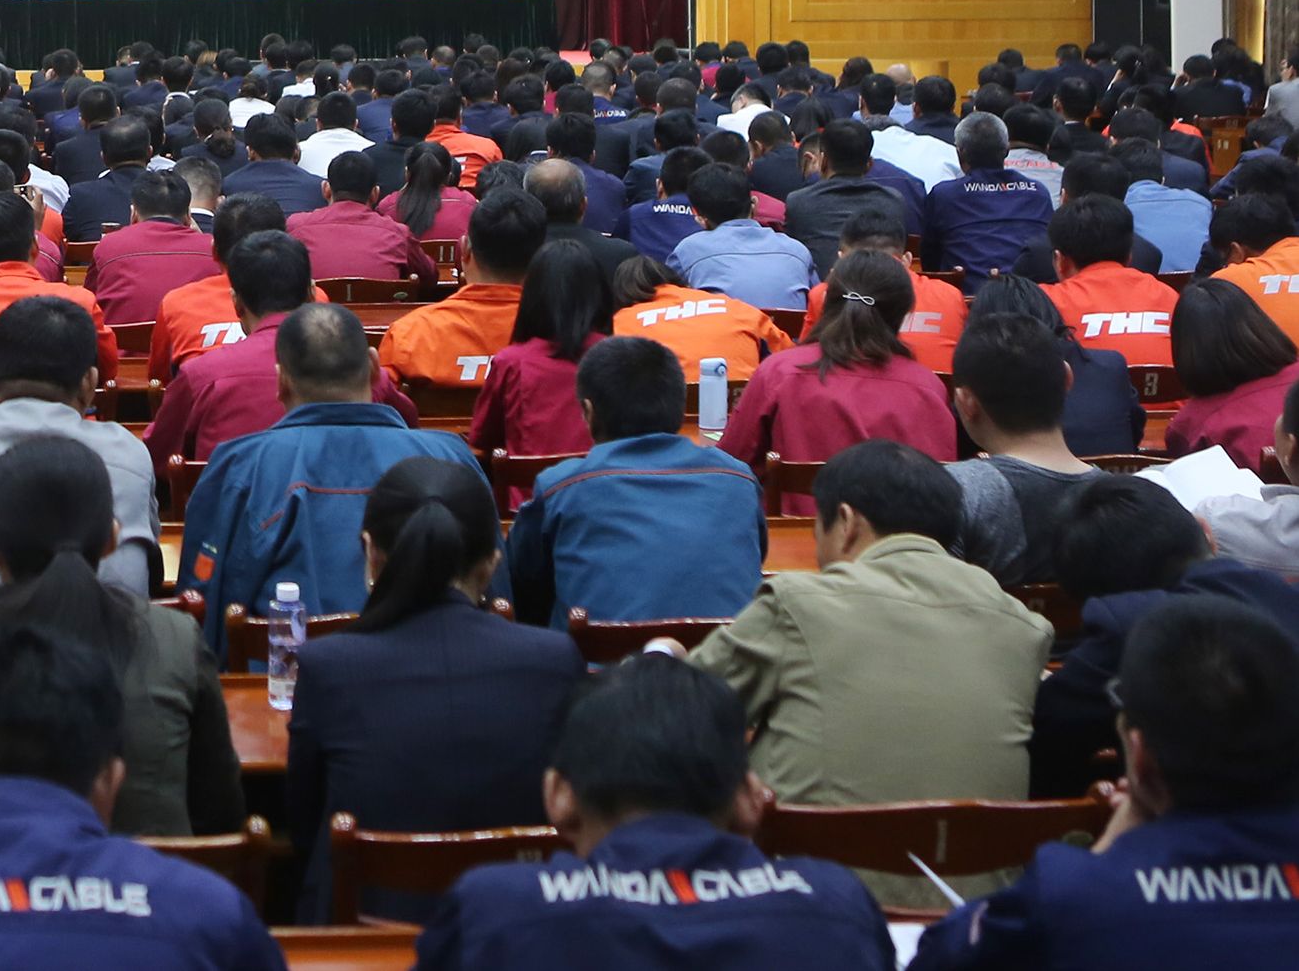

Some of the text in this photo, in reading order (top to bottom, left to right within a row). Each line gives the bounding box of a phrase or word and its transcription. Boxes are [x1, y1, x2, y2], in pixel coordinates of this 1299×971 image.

[653, 203, 693, 215] WANDA
[636, 298, 728, 327] THC
[1081, 311, 1171, 338] THC
[29, 875, 152, 917] CABLE
[538, 862, 678, 905] WANDA
[1135, 865, 1291, 903] WANDA
